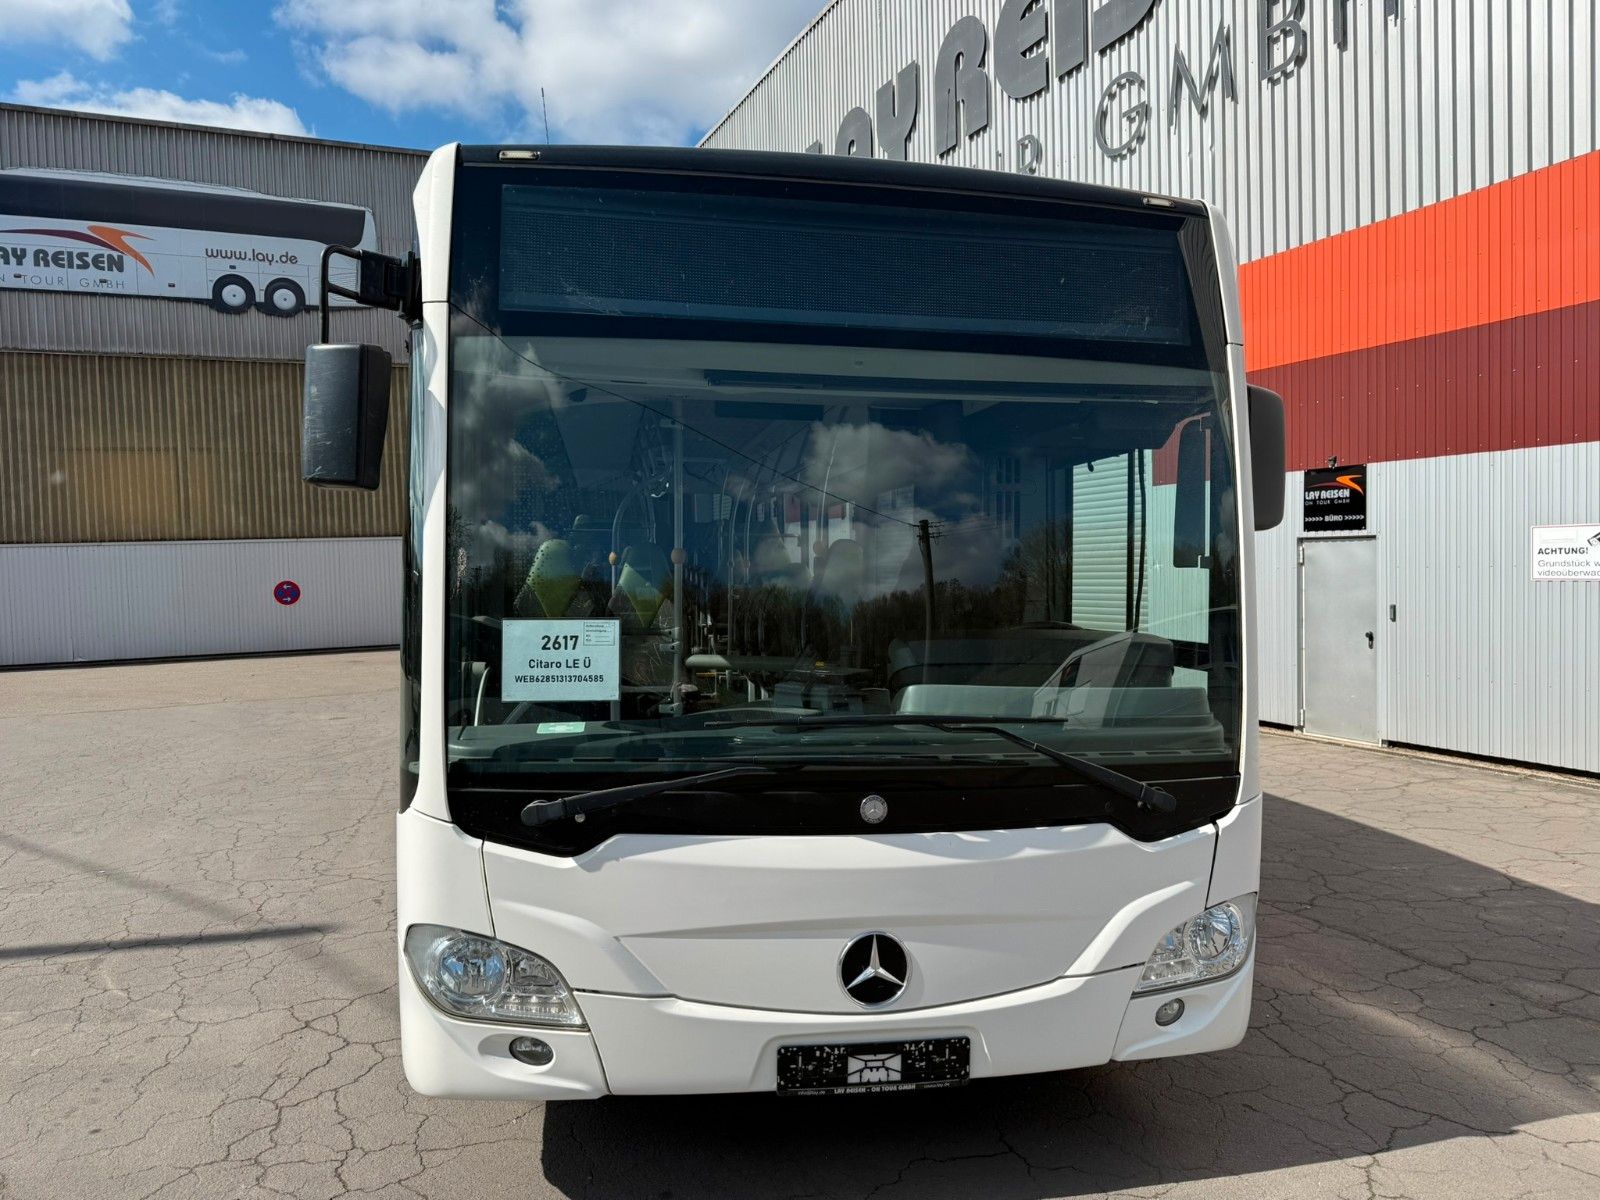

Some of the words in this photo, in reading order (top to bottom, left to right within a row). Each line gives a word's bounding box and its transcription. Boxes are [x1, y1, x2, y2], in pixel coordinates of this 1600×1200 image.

[1094, 0, 1398, 157] GMB
[33, 248, 125, 273] REISEN
[205, 248, 299, 266] www.lay.de
[19, 274, 64, 286] TOUR
[79, 277, 125, 290] GMBH
[1304, 491, 1320, 500] LAY
[1320, 488, 1350, 499] REISEN
[1324, 514, 1343, 522] BÜRO
[1537, 547, 1589, 555] ACHTUNG!
[1537, 559, 1591, 568] Grundstück
[541, 635, 579, 651] 2617
[528, 658, 562, 669] Citaro
[565, 659, 580, 669] LE
[583, 656, 591, 669] Ü
[514, 674, 604, 683] WEB62851313704585
